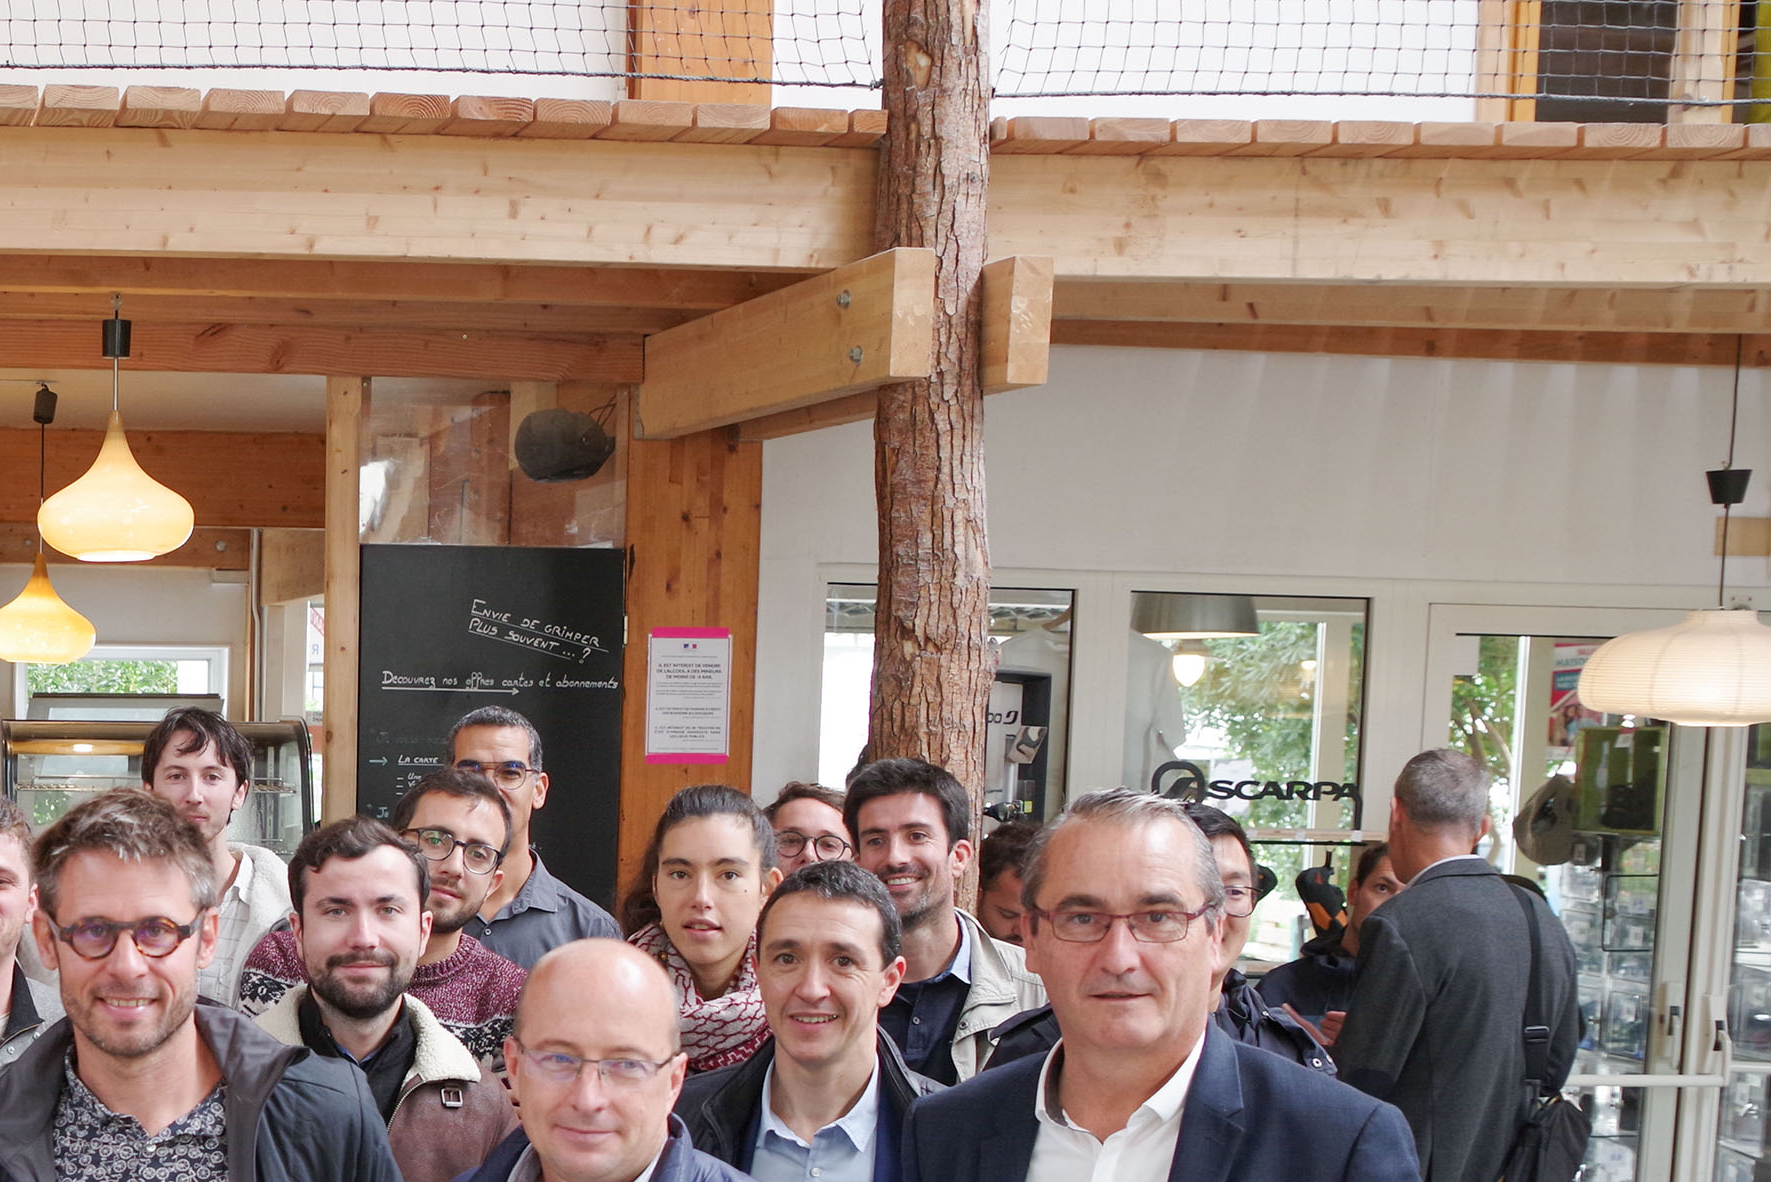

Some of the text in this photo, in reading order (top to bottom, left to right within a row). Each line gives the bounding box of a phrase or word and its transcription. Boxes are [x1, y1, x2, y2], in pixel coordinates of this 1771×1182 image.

[469, 617, 498, 635] PLUS
[503, 630, 559, 650] SOUVENT
[520, 618, 540, 630] DE
[442, 678, 458, 686] nos
[466, 672, 494, 689] offres
[502, 673, 534, 687] cartes
[539, 673, 551, 687] et
[555, 674, 619, 689] abonnements
[1206, 780, 1360, 801] SCARPA
